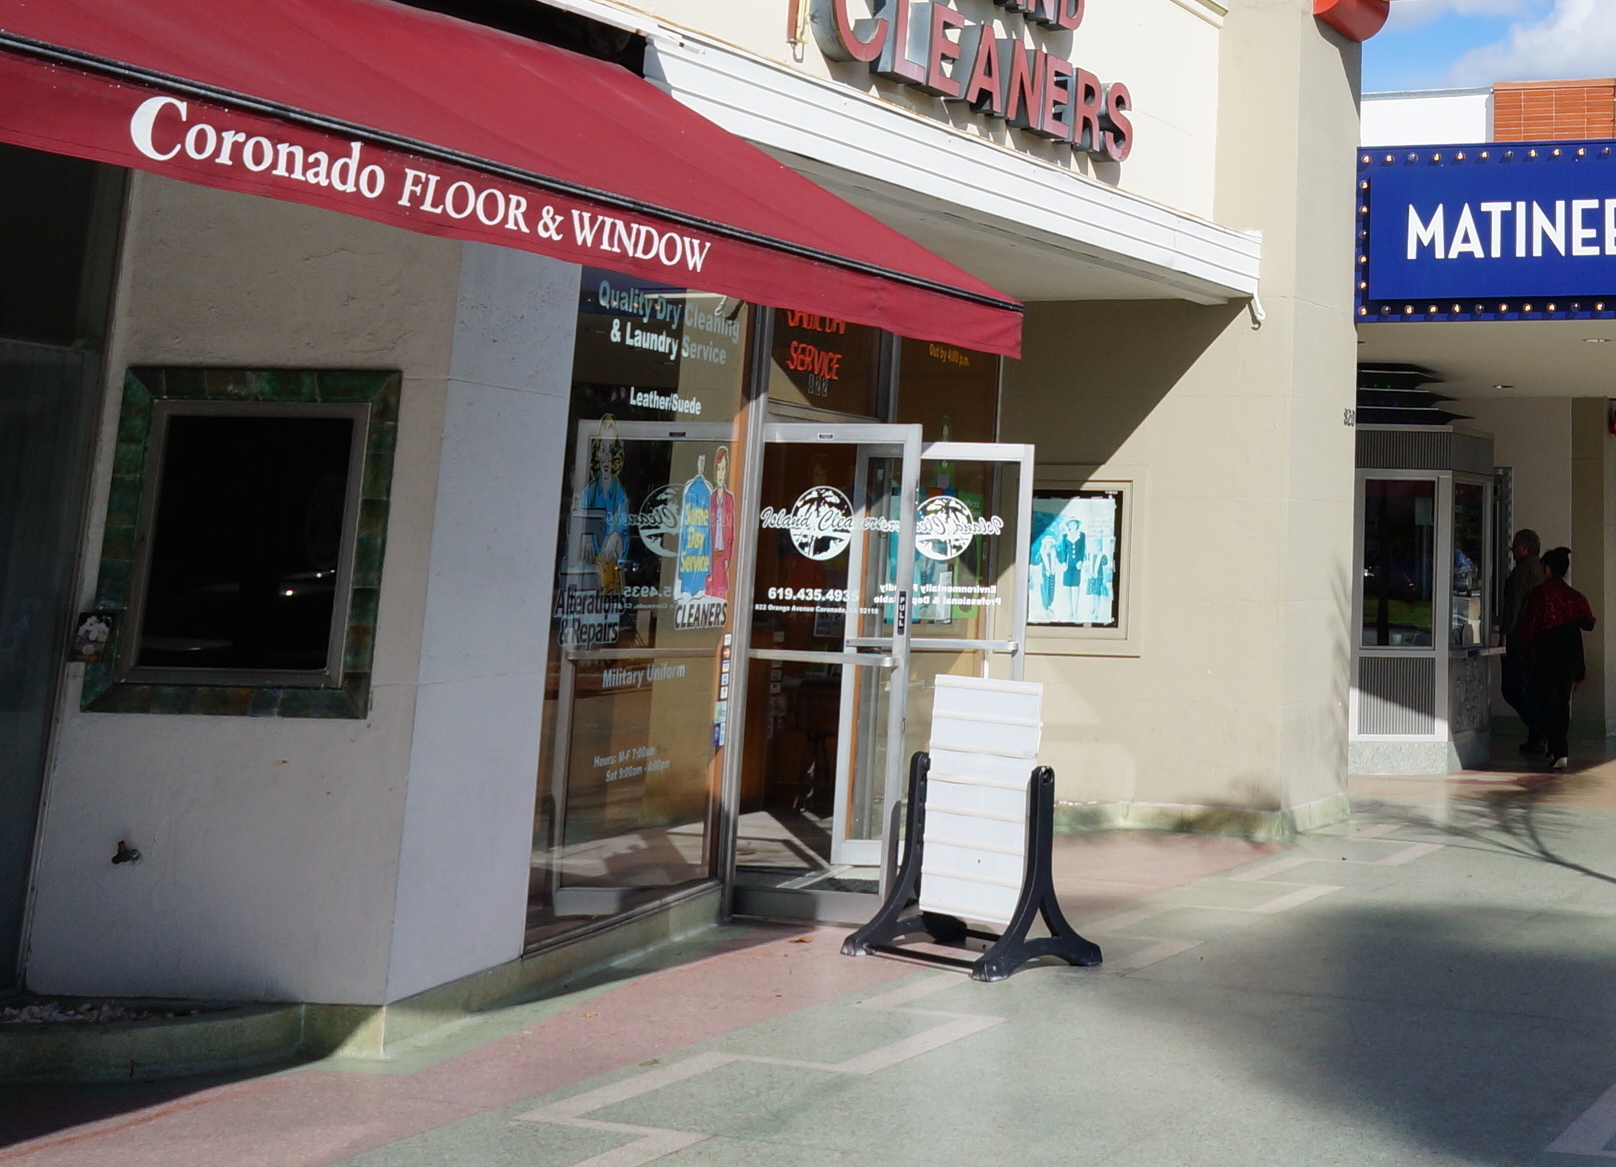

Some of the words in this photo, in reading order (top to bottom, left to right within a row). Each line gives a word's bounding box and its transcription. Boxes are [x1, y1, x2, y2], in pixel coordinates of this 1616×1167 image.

[130, 94, 386, 199] Coronado
[397, 167, 530, 234] FLOOR
[537, 205, 564, 241] &
[570, 207, 712, 274] WINDOW
[599, 280, 654, 324] Quality
[656, 295, 681, 330] Dry
[684, 302, 741, 345] Cleaning
[610, 318, 621, 343] &
[625, 321, 680, 361] Laundry
[681, 335, 728, 365] Service
[785, 340, 843, 381] SERVICE
[629, 386, 702, 415] Leather/Suede
[684, 502, 710, 526] Same
[759, 506, 810, 529] Island
[687, 526, 705, 554] Day
[680, 552, 710, 573] Service
[555, 586, 627, 616] Alterations
[767, 587, 859, 603] 619.435.4935
[767, 604, 791, 612] Orange
[815, 606, 848, 614] Coronado,
[674, 601, 729, 629] CLEANERS
[570, 614, 620, 652] Repairs
[602, 666, 645, 689] Military
[646, 663, 686, 683] Uniform
[594, 755, 617, 768] Hours:
[605, 769, 618, 783] Sat
